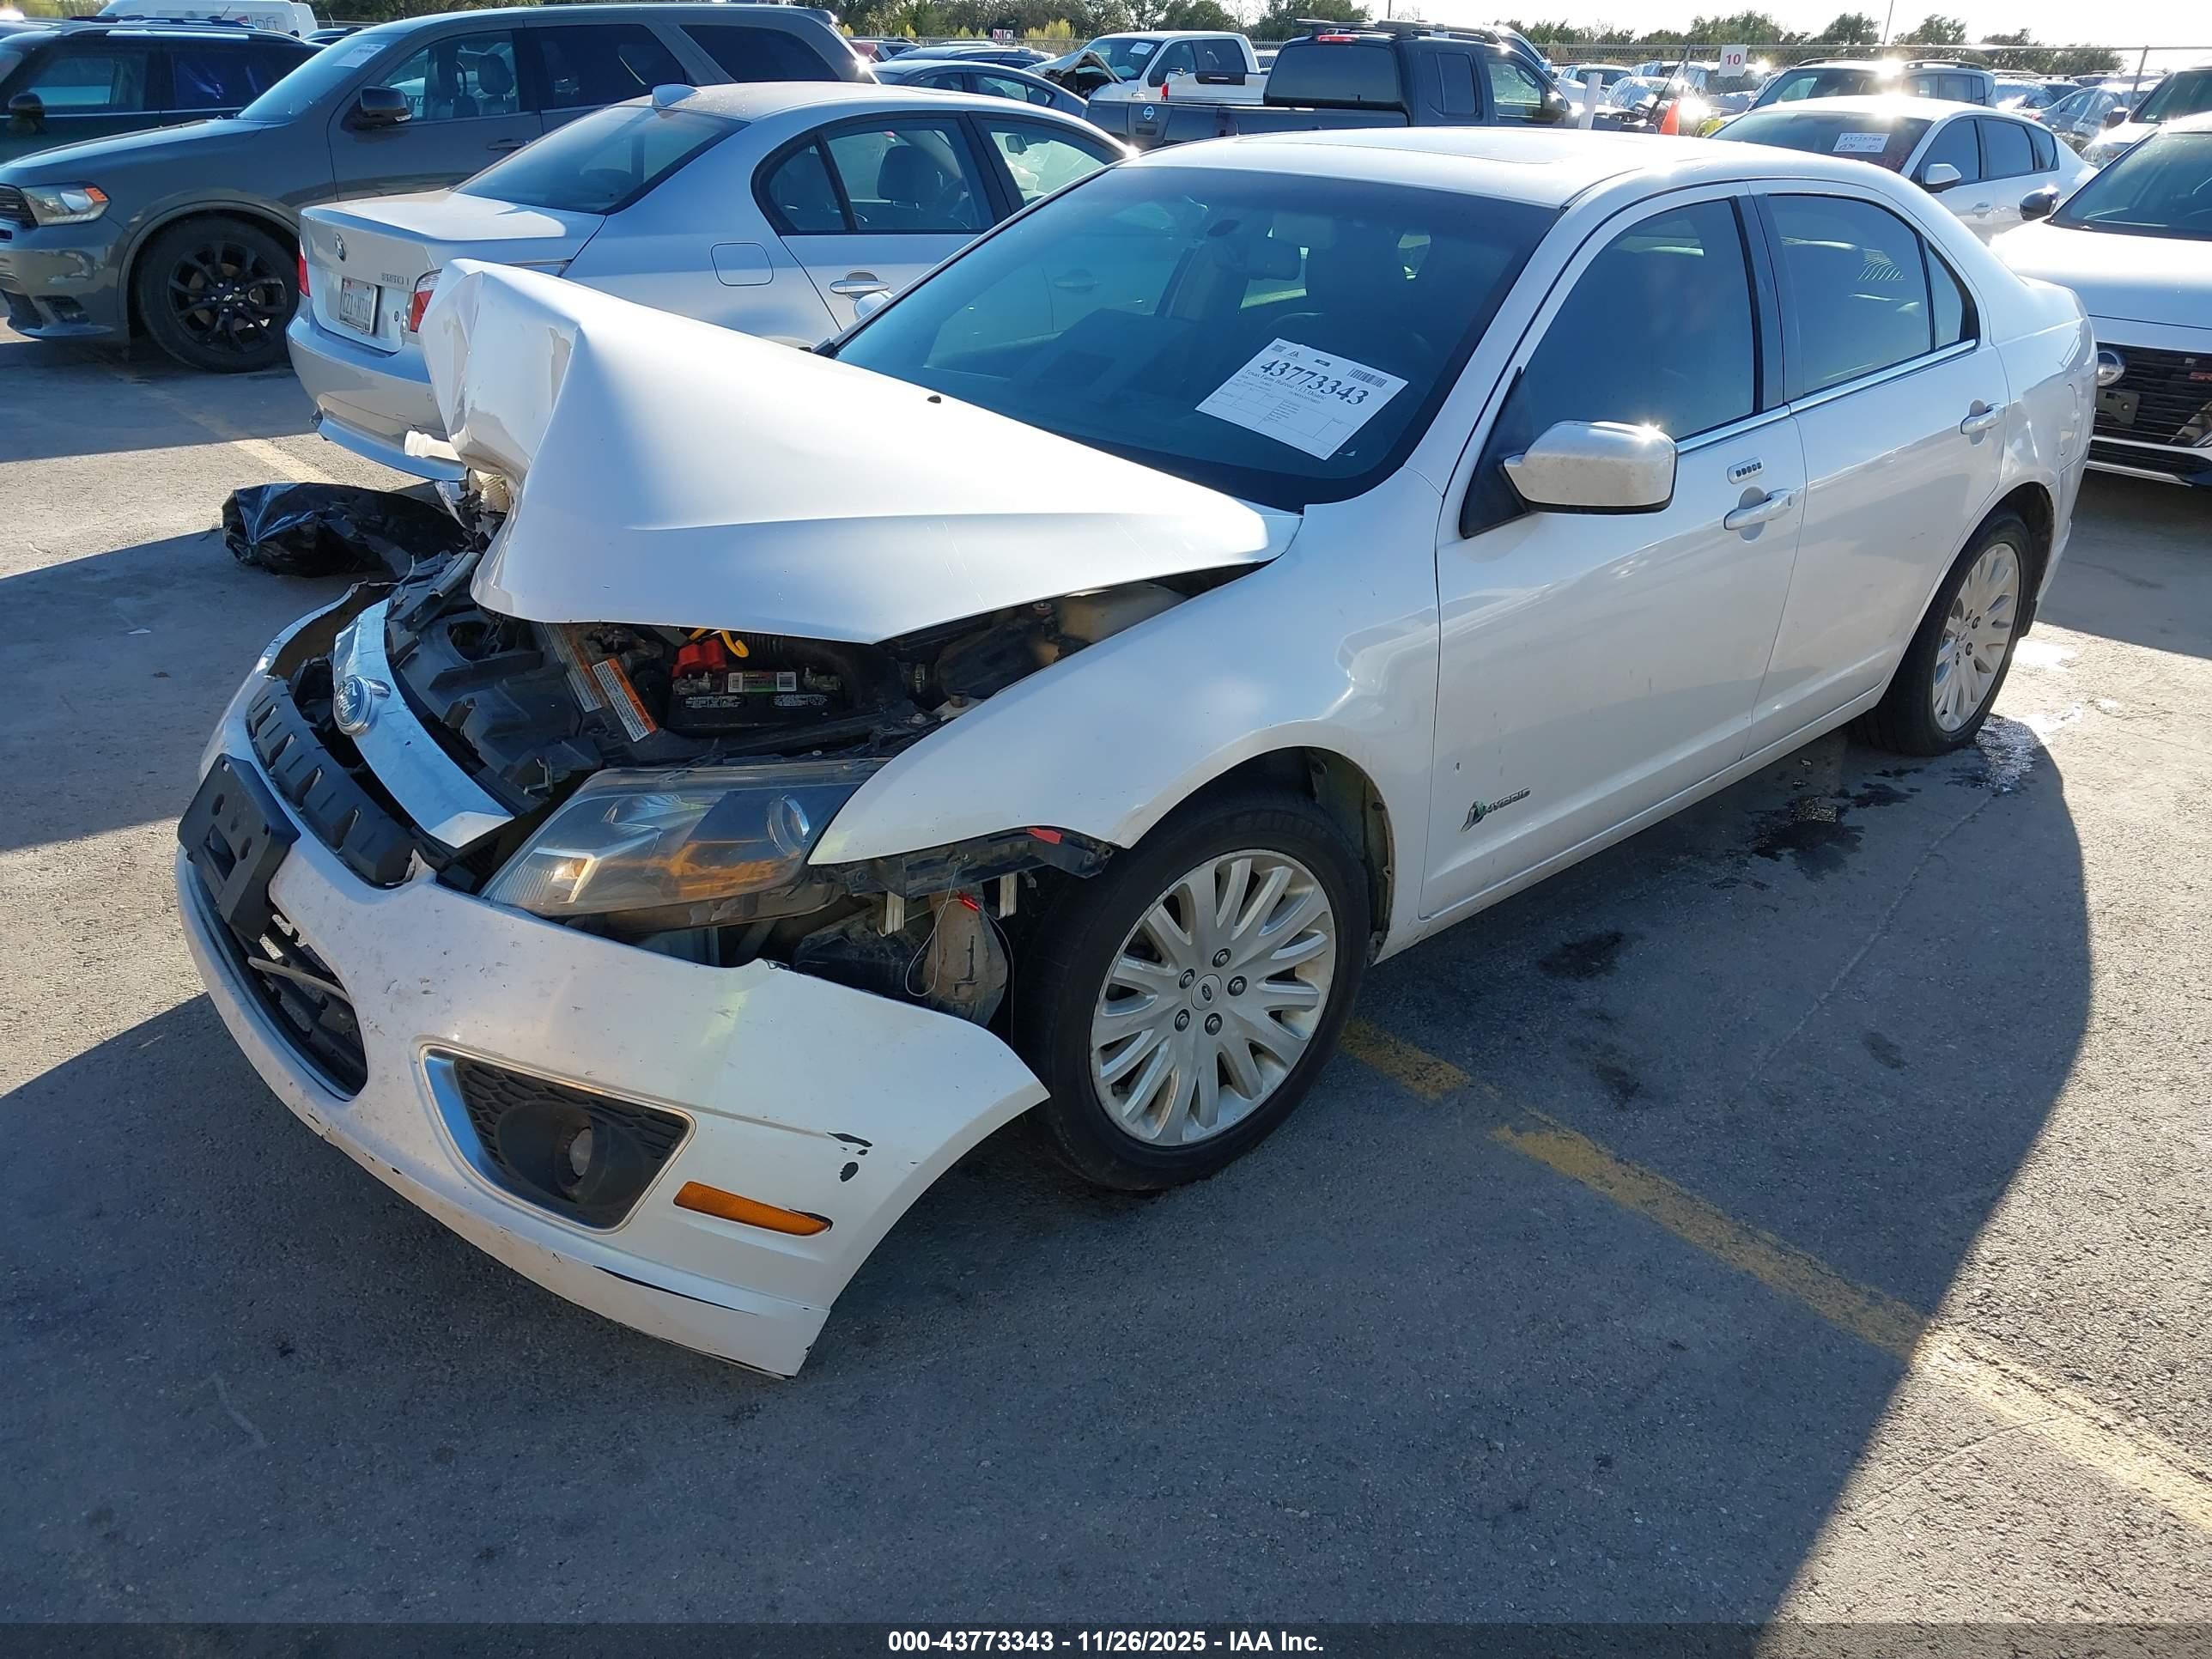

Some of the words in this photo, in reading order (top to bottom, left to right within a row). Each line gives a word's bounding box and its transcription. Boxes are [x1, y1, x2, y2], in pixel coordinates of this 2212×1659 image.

[1726, 53, 1741, 65] 10
[1260, 359, 1370, 405] 43773343
[336, 681, 358, 718] Ford
